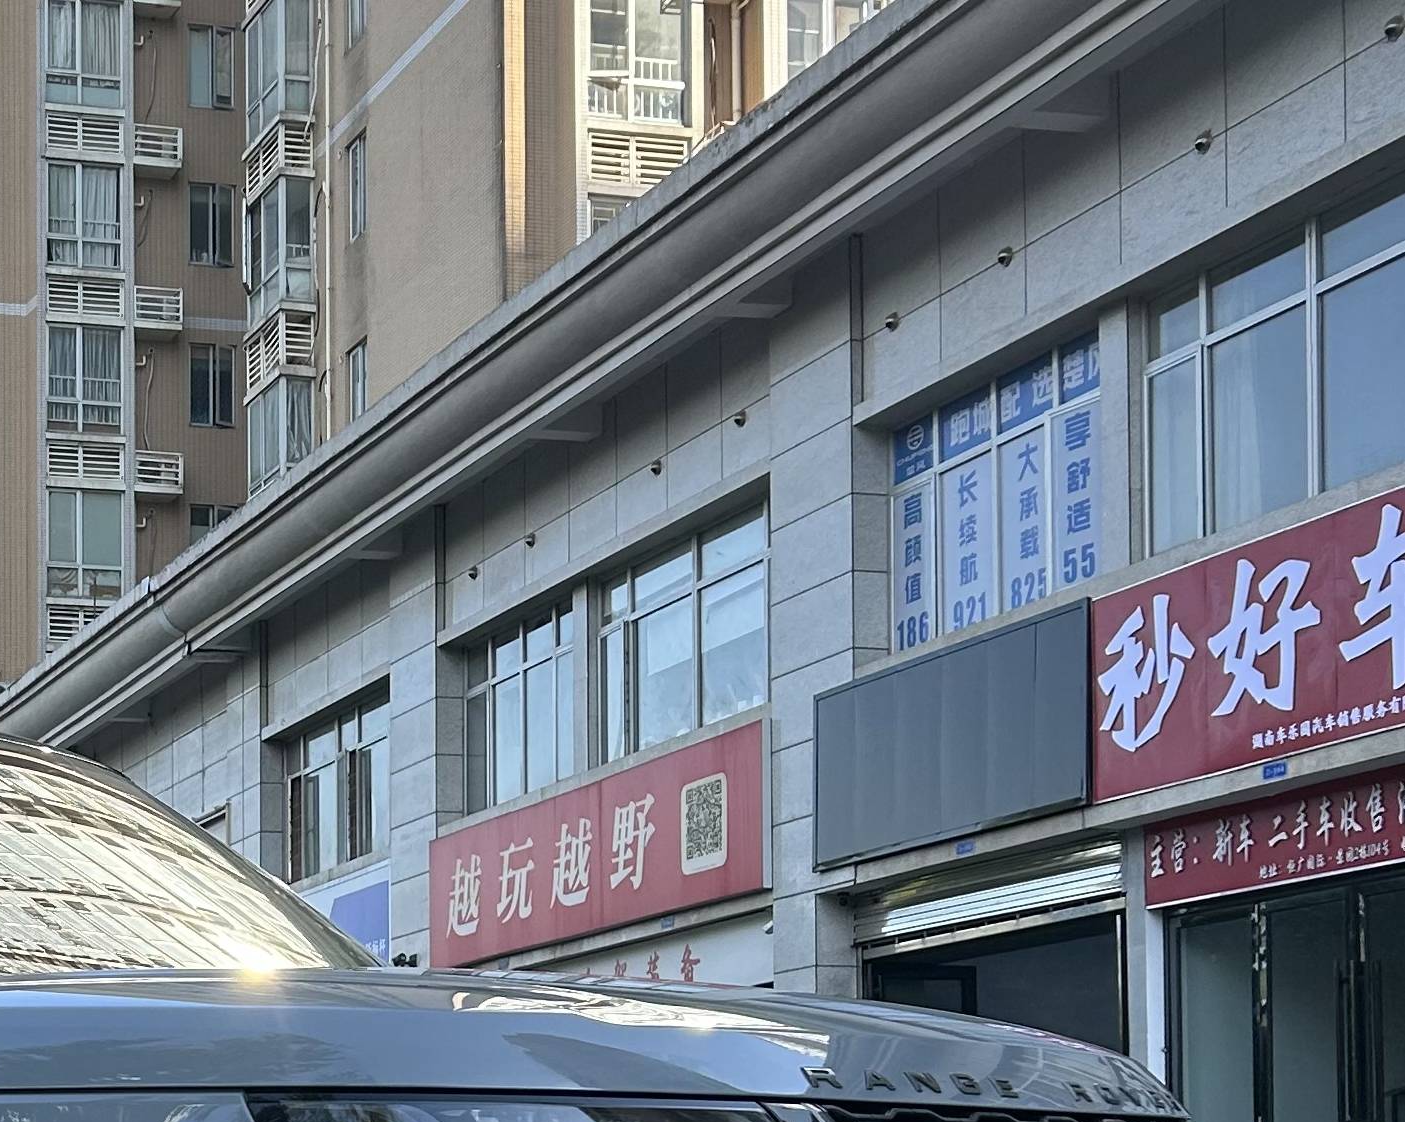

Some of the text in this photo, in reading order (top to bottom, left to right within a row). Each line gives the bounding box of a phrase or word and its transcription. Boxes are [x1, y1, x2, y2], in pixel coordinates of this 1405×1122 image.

[958, 470, 978, 587] 长续航
[1018, 442, 1039, 560] 大承载
[1065, 410, 1092, 535] 享舒适
[897, 542, 1096, 651] 186 921 825 55
[904, 493, 923, 604] 高颜值
[446, 793, 656, 939] 越玩越野
[1212, 814, 1255, 867] 新车
[800, 1065, 1021, 1099] RANGE
